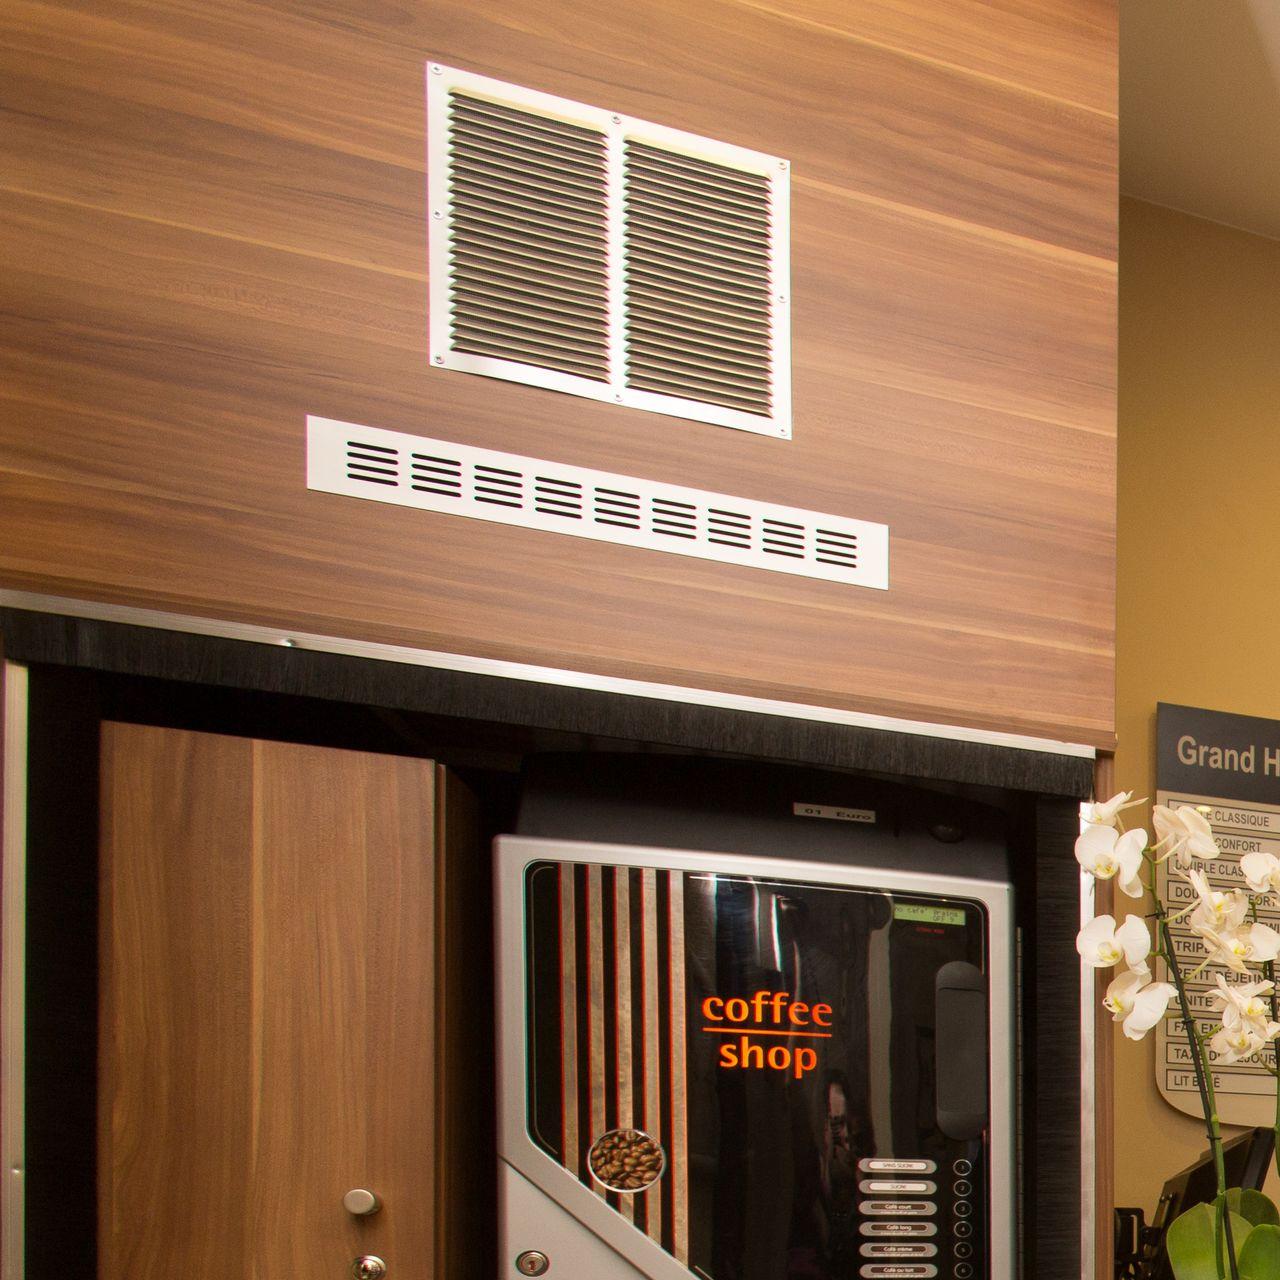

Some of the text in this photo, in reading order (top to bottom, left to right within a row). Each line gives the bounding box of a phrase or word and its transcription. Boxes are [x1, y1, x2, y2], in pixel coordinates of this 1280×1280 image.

[1177, 735, 1255, 774] Grand
[836, 811, 872, 821] Euro
[1214, 811, 1270, 827] CLASSIQUE
[1215, 838, 1262, 852] CONFORT
[702, 991, 833, 1026] coffee
[720, 1036, 817, 1079] shop
[1174, 1075, 1189, 1086] LIT
